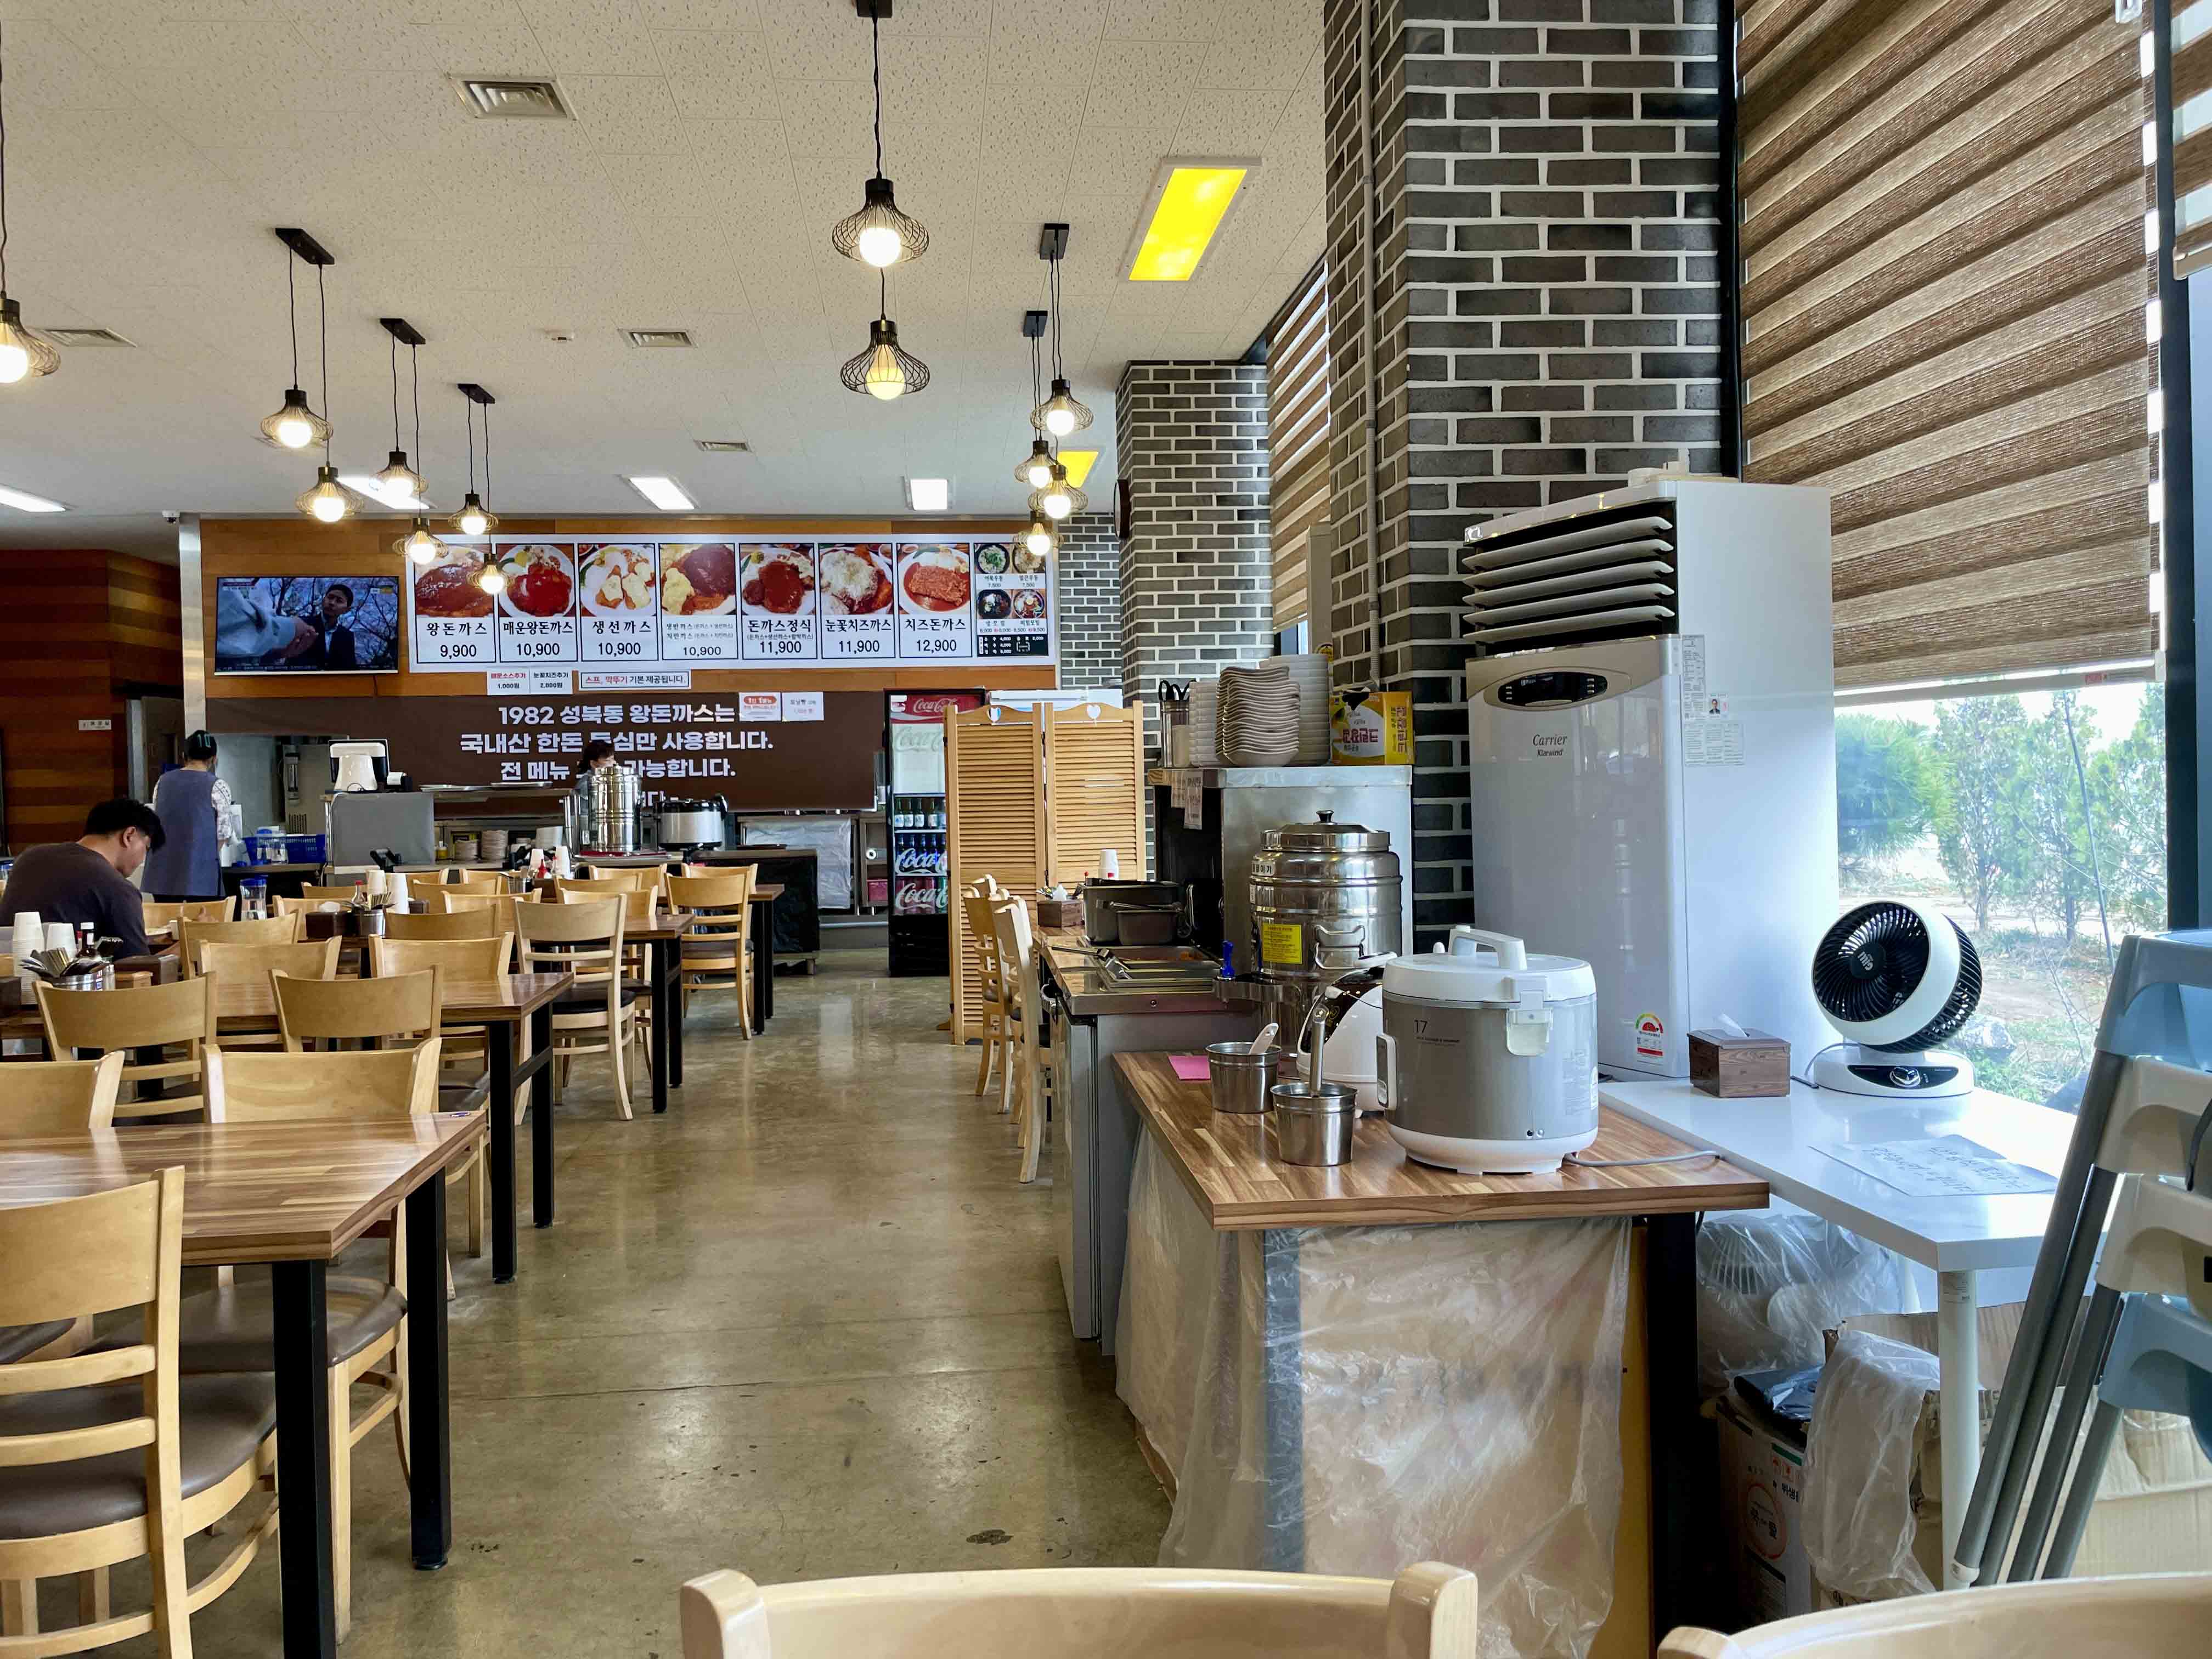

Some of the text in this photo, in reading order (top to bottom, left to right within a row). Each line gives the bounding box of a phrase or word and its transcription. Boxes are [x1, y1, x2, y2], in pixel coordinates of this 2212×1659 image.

[426, 623, 487, 636] 왕돈까스
[503, 621, 573, 635] 매운왕돈까스
[592, 620, 651, 634] 생선까스
[748, 619, 811, 633] 돈까스정식
[825, 618, 891, 632] 눈꽃치즈까스
[905, 618, 966, 631] 치즈돈까스
[440, 645, 477, 659] 9,900
[516, 643, 560, 657] 10,900
[599, 642, 641, 657] 10,900
[684, 646, 721, 657] 10,900
[760, 641, 802, 655] 11,900
[839, 640, 880, 654] 11,900
[917, 639, 957, 653] 12,900
[630, 675, 644, 684] 기본
[499, 704, 735, 725] 1982 성북동 왕돈까스는
[460, 732, 531, 754] 국내산
[537, 732, 583, 753] 한돈
[662, 731, 774, 751] 사용합니다.
[1533, 734, 1567, 746] Carrier
[501, 761, 521, 781] 전
[527, 761, 571, 780] 메뉴
[1414, 1019, 1428, 1033] 17
